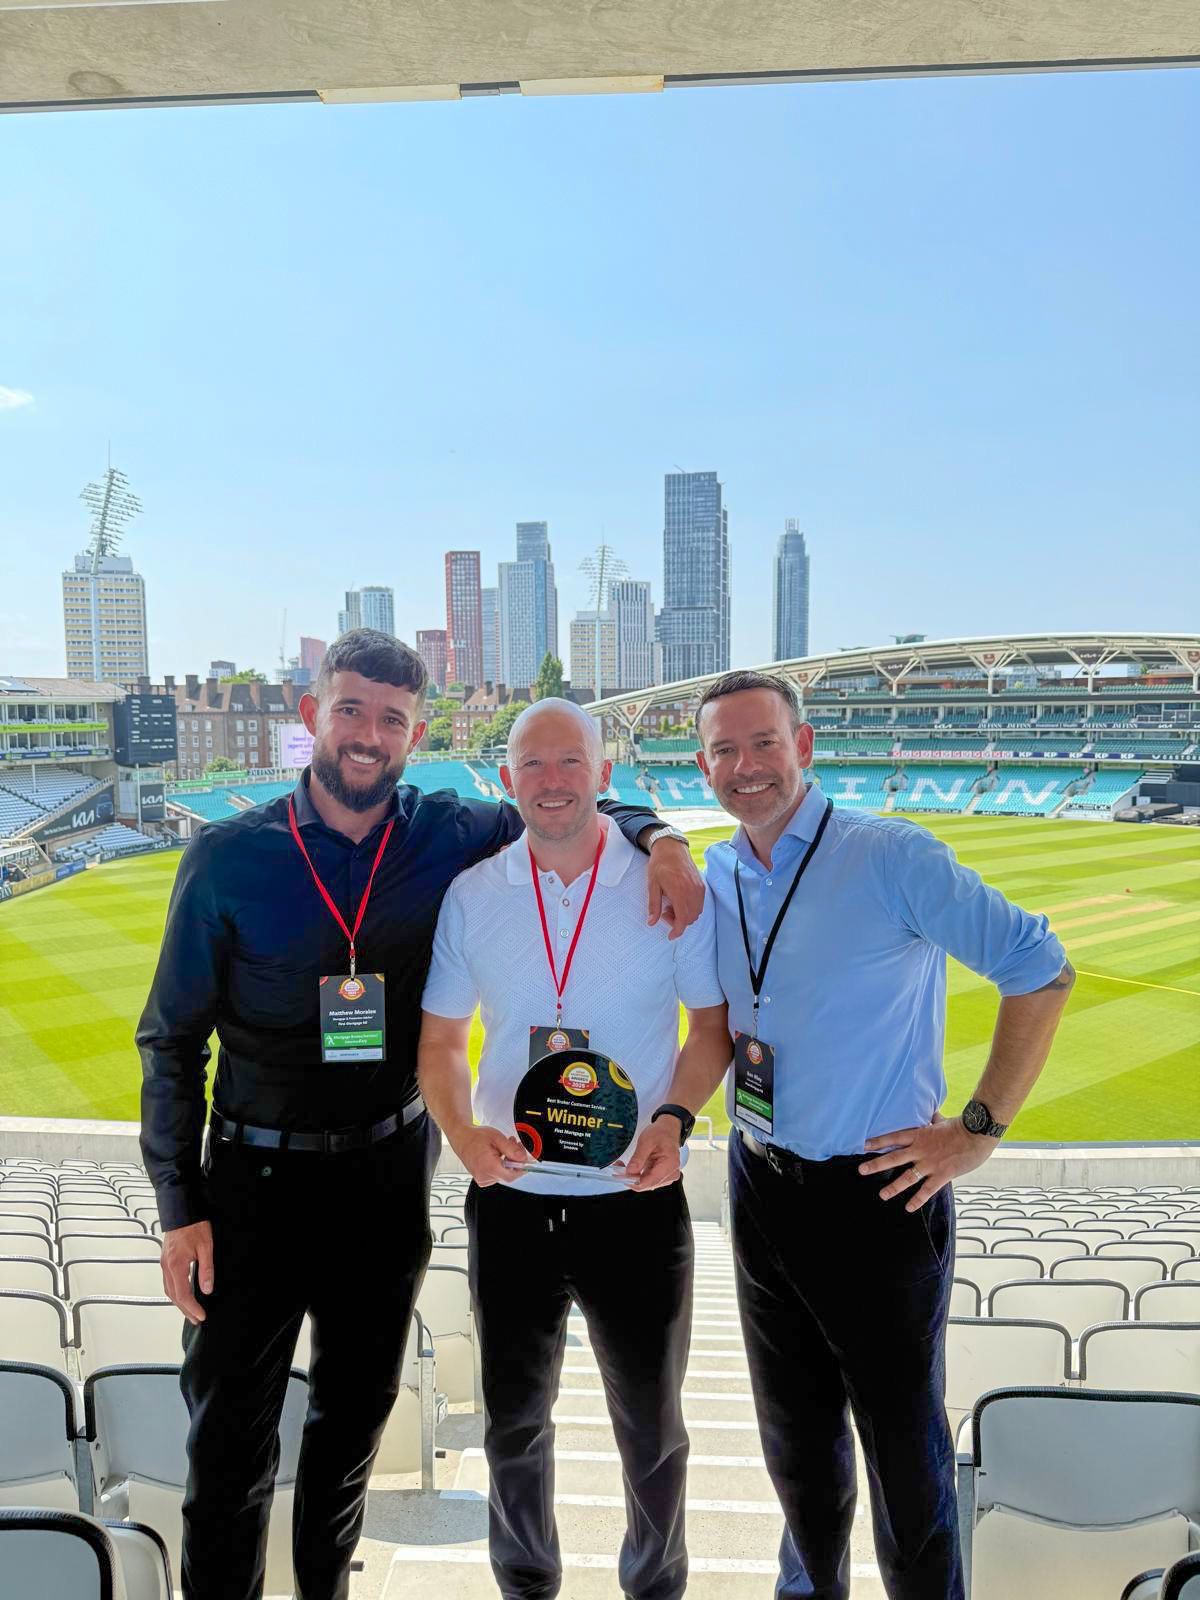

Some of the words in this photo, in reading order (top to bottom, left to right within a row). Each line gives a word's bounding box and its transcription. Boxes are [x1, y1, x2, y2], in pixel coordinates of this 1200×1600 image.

[142, 796, 163, 804] KIA
[72, 809, 95, 828] KIA
[547, 1107, 603, 1128] Winner
